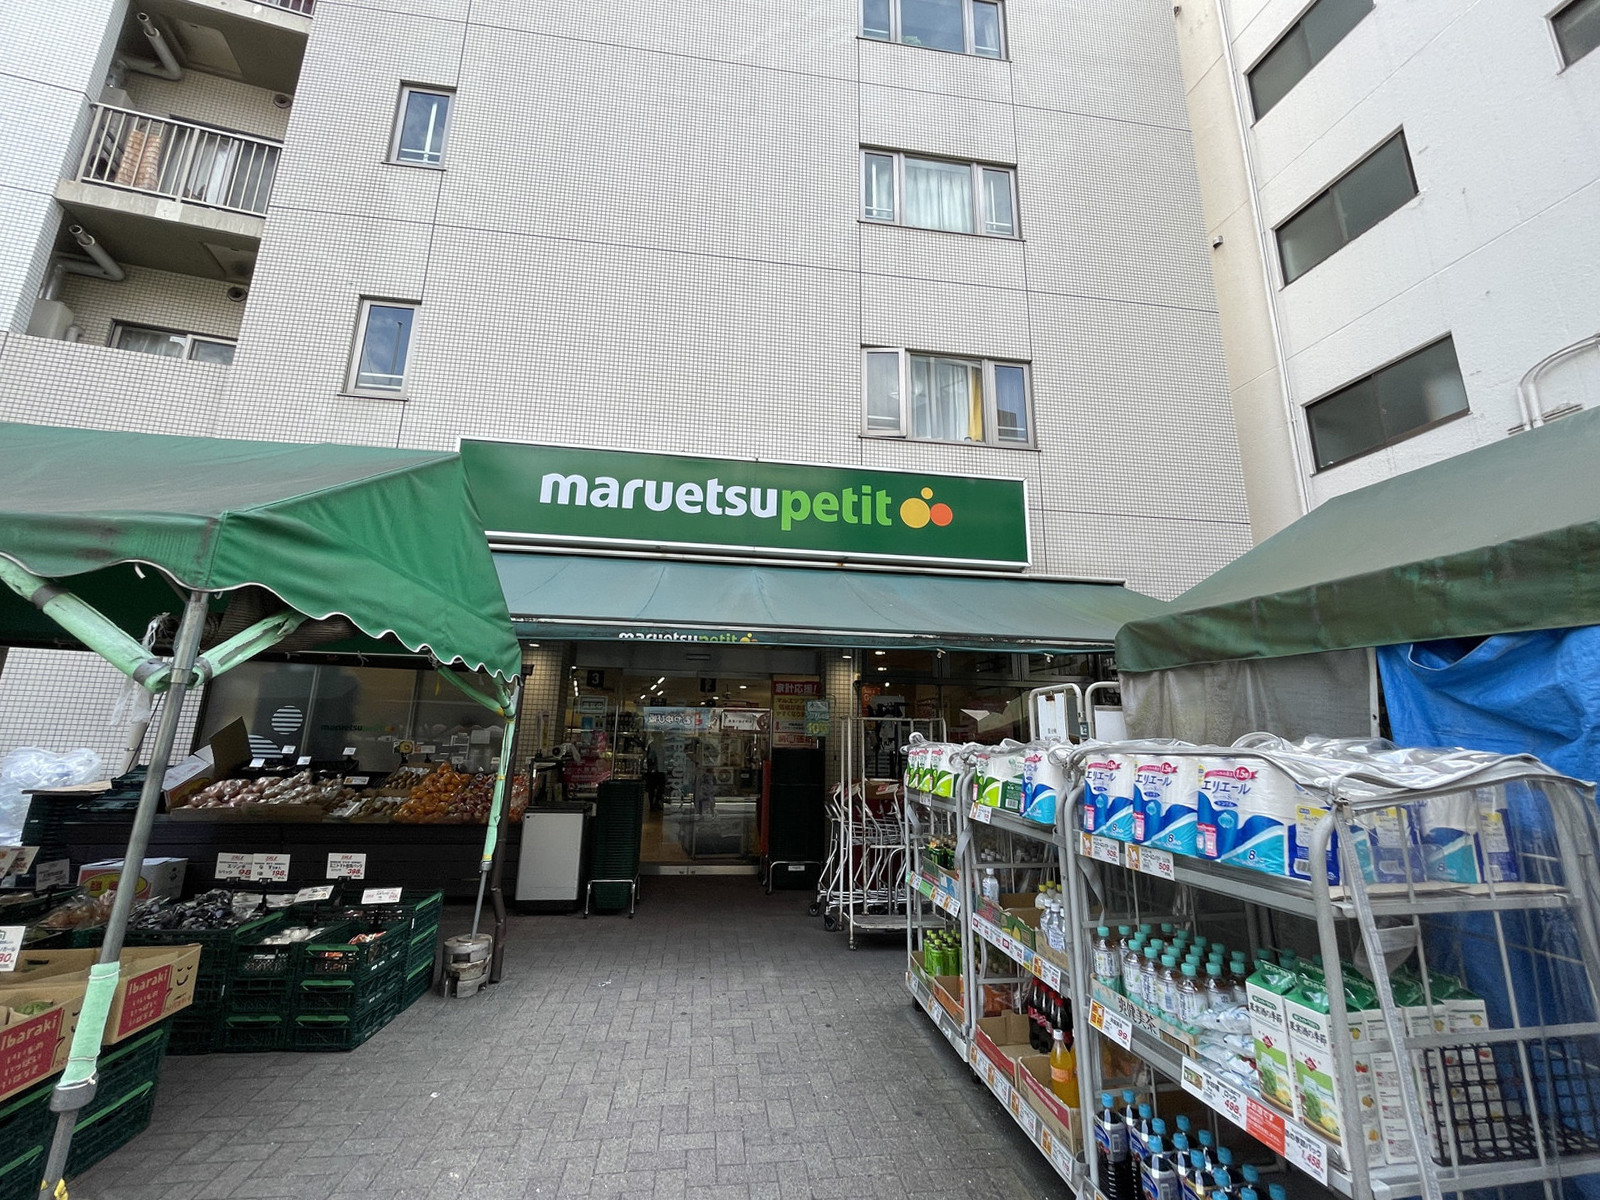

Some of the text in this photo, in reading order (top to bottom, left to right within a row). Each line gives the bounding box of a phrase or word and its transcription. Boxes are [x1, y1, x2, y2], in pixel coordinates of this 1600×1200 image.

[591, 673, 600, 685] 3
[1086, 771, 1117, 782] エリエール
[1135, 774, 1173, 787] エリエール
[1202, 780, 1251, 795] エリエール
[128, 969, 169, 996] Ibaraki
[1117, 995, 1158, 1035] 爽健美茶
[0, 1015, 58, 1051] Ibaraki
[1224, 1099, 1240, 1114] 498
